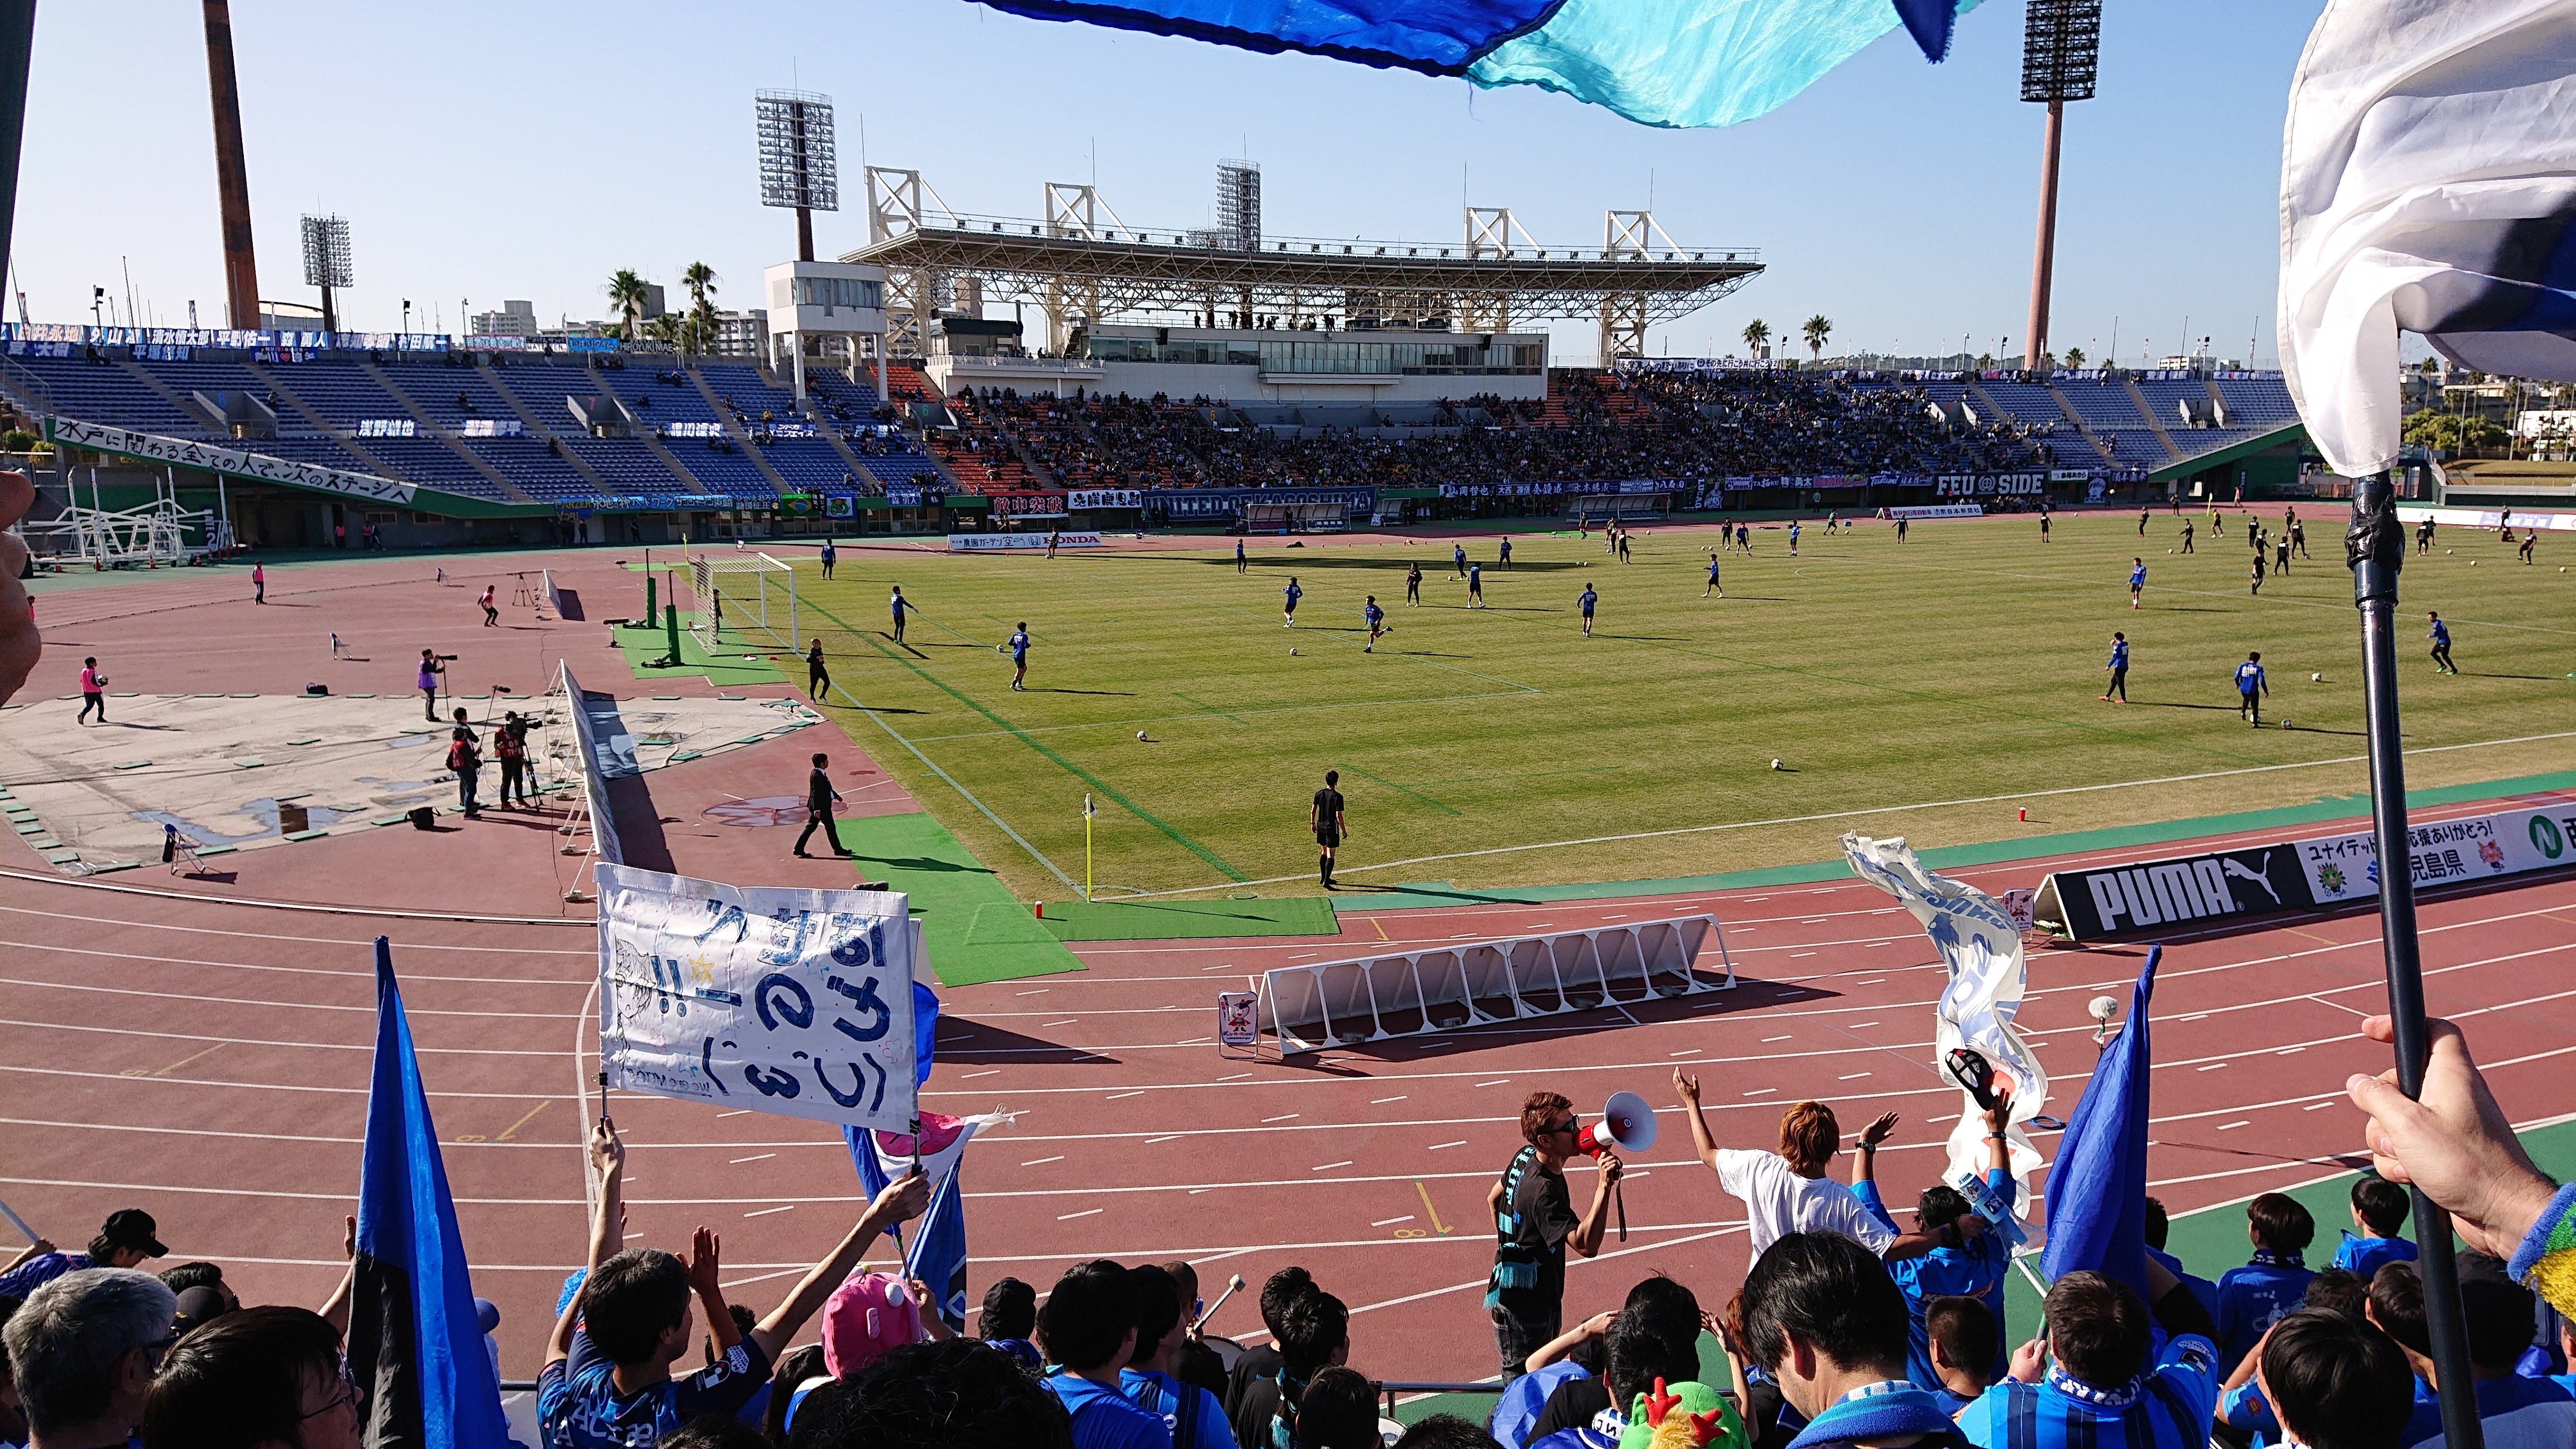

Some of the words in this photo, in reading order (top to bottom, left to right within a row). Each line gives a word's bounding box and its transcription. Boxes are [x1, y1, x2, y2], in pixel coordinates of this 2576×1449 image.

[1936, 476, 1975, 496] FEU
[1998, 474, 2044, 494] SIDE
[994, 497, 1063, 514] 敵中突破
[1073, 492, 1141, 507] 必勝鹿児島
[1144, 494, 1223, 518] UNITED
[2087, 860, 2236, 931] PUMA
